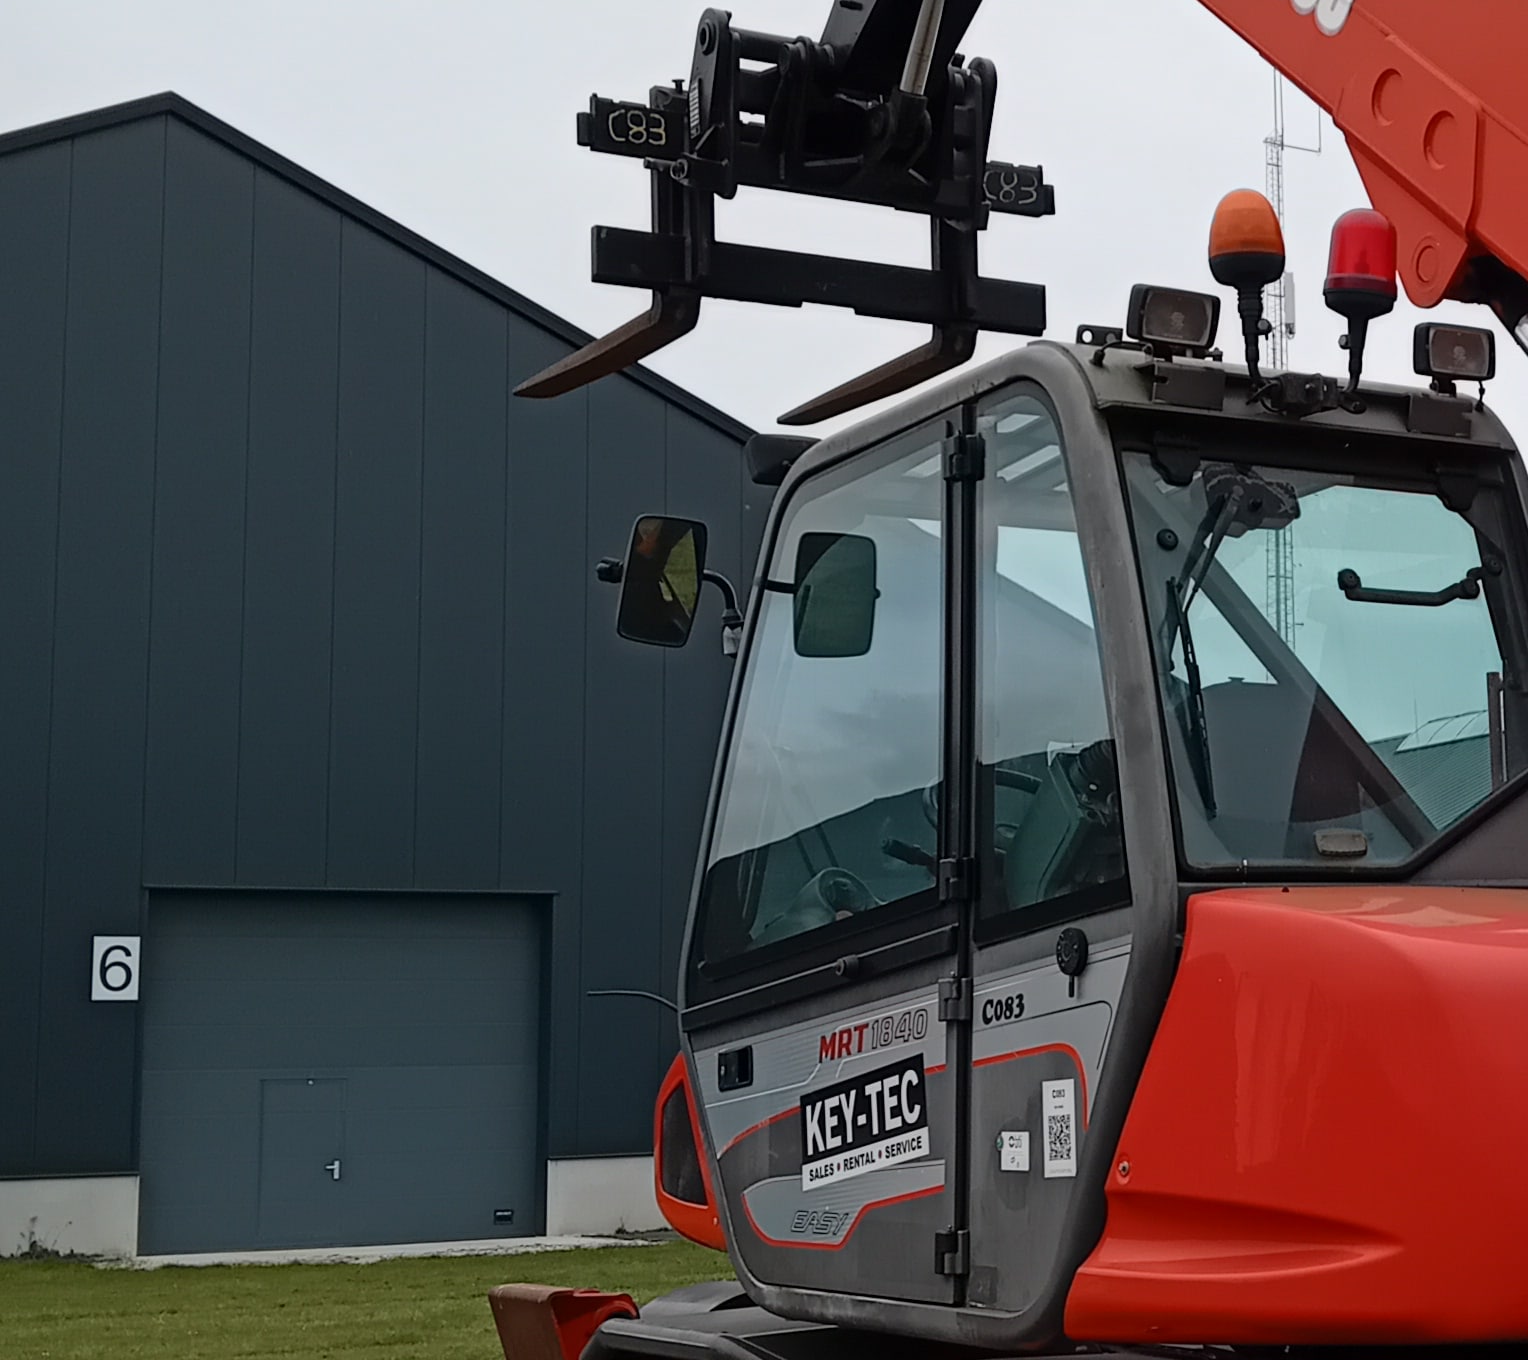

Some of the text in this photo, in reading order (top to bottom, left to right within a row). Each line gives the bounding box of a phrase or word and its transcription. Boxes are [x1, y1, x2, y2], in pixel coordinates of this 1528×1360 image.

[608, 109, 666, 146] C83
[983, 169, 1038, 204] C83
[99, 944, 132, 992] 6
[982, 993, 1025, 1025] C083
[818, 1009, 928, 1063] MRT 1840
[806, 1069, 921, 1156] KEY-TEC
[809, 1136, 922, 1182] SALES RENTAL SERVICE
[791, 1210, 849, 1236] EASY
